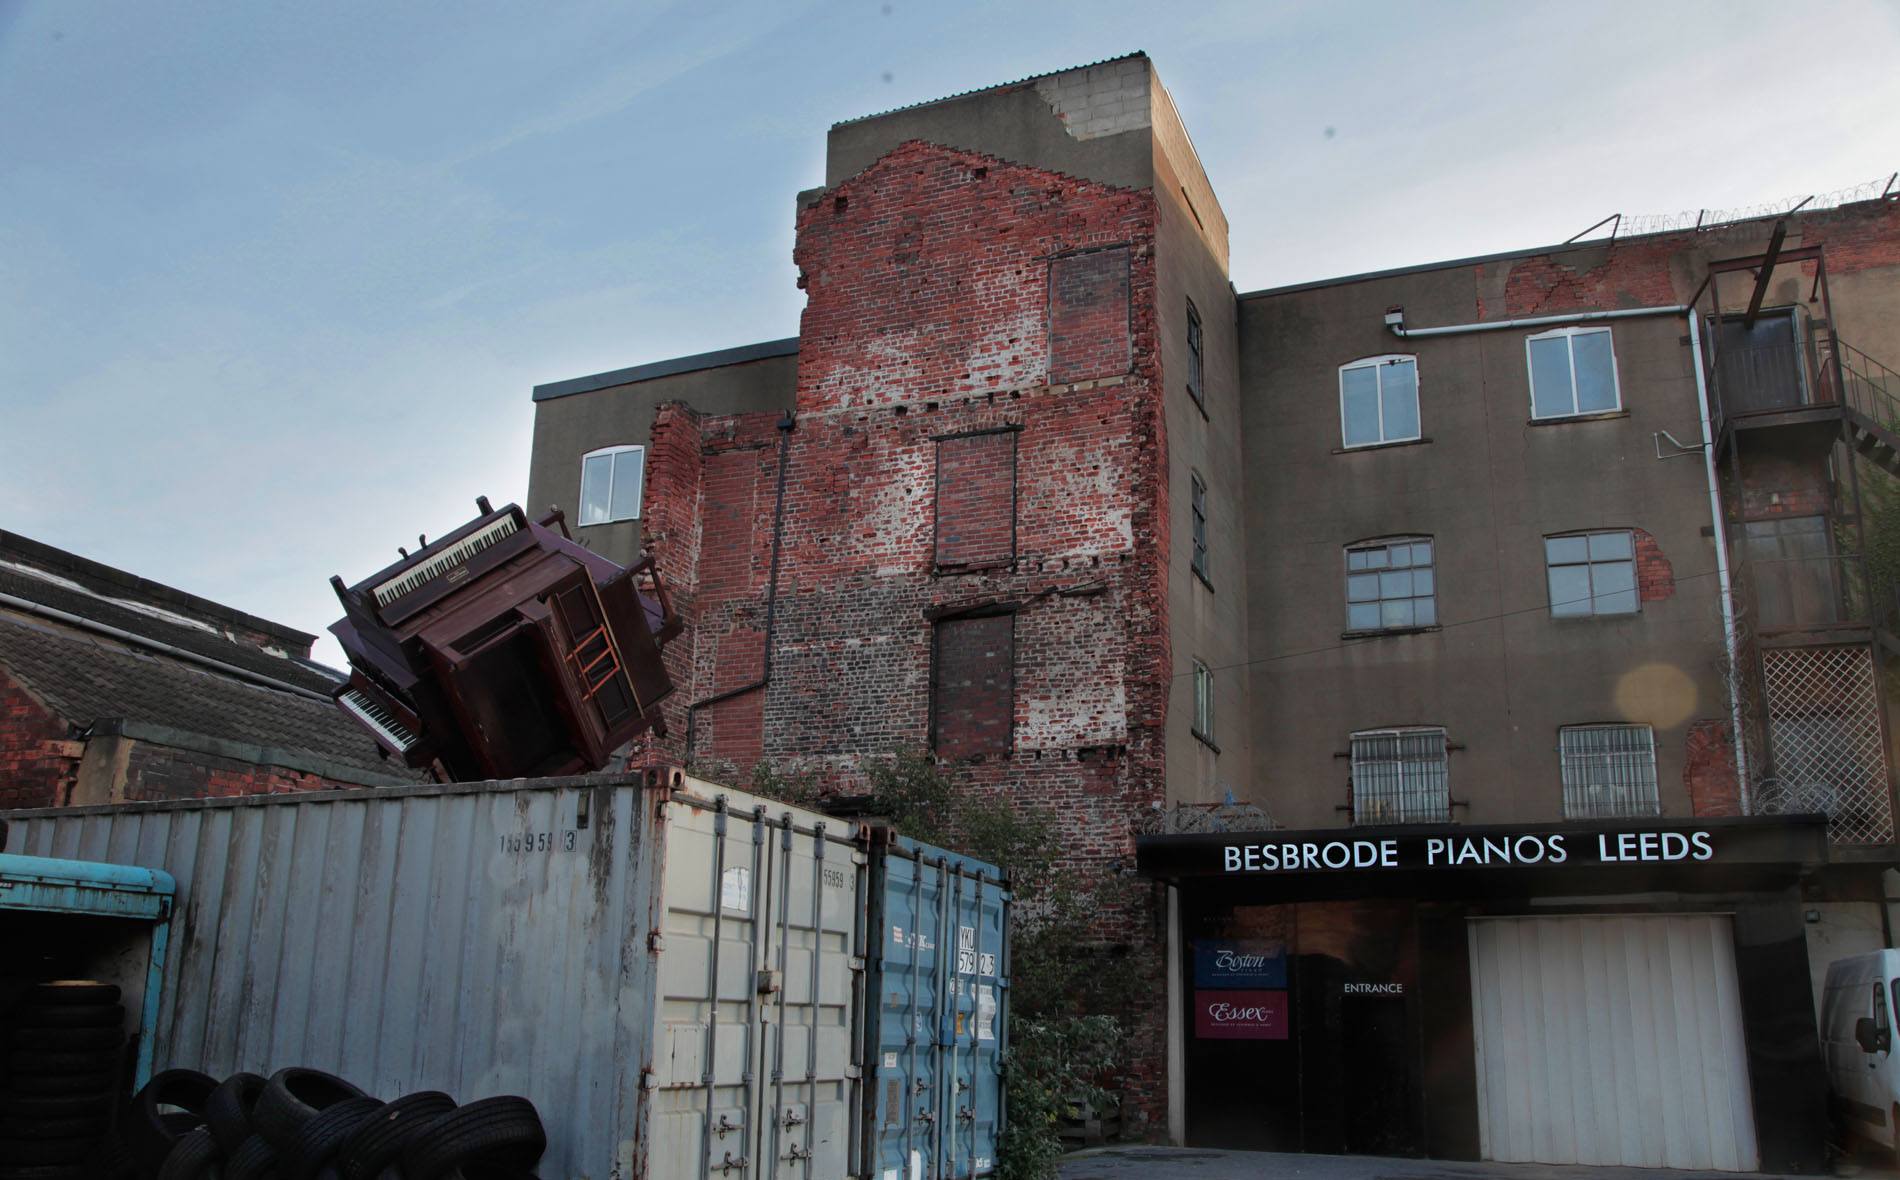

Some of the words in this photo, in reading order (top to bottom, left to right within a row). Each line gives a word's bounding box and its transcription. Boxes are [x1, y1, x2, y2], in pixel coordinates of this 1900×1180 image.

[566, 831, 575, 851] 3
[1224, 840, 1399, 872] BESBRODE
[1427, 834, 1567, 865] PIANOS
[1598, 831, 1713, 862] LEEDS
[1216, 950, 1265, 972] Boston
[1344, 983, 1403, 993] ENTRANCE
[1208, 1002, 1268, 1022] Essex
